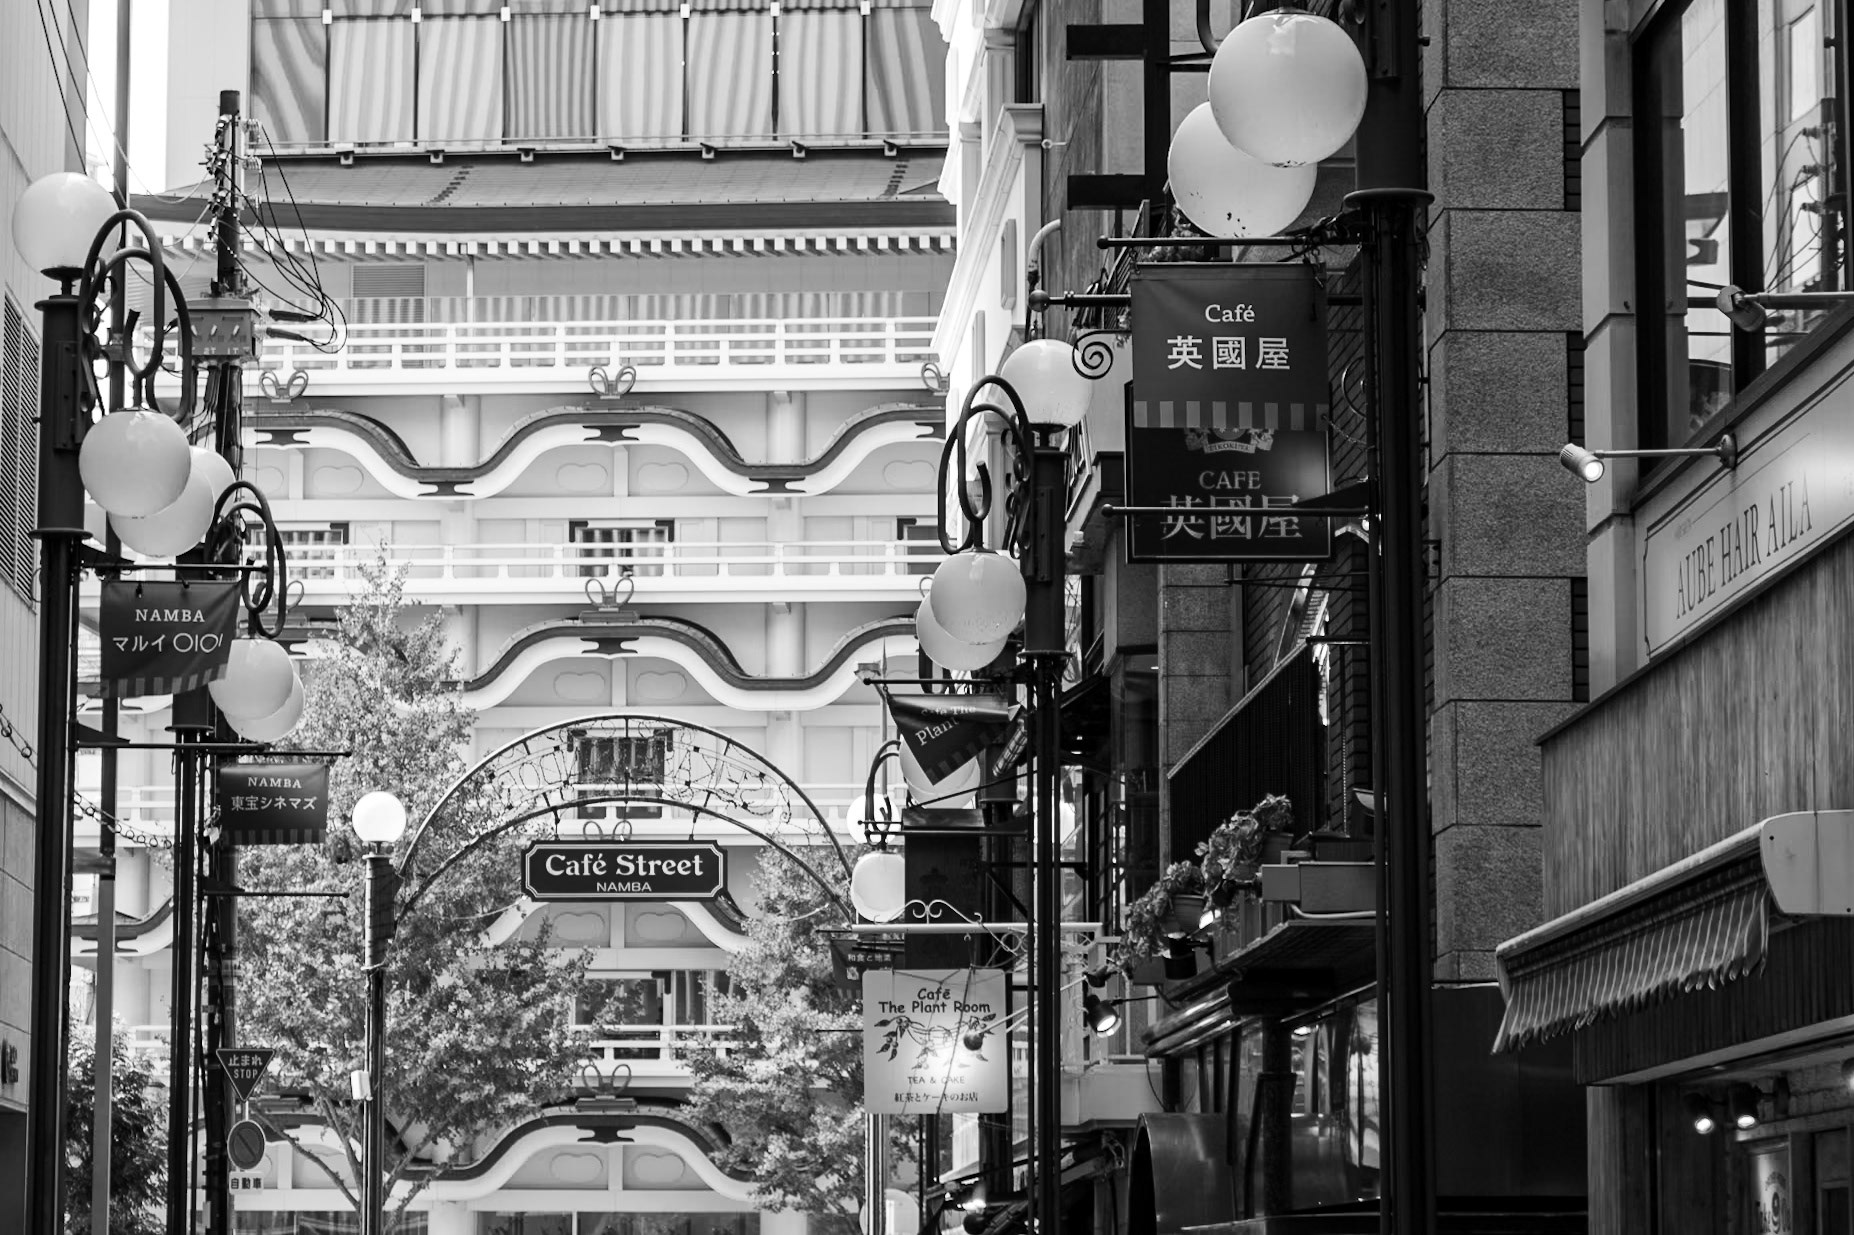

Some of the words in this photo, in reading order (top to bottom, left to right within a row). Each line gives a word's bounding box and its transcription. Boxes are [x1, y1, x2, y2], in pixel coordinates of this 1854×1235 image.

[1204, 304, 1255, 323] Café
[1166, 335, 1291, 370] 英國屋
[1199, 470, 1261, 490] CAFE
[1159, 494, 1303, 541] 英國屋
[1676, 536, 1716, 619] AUBE
[1720, 503, 1762, 587] HAIR
[1766, 471, 1813, 557] AILA
[135, 608, 206, 622] NAMBA
[112, 634, 166, 653] マルイ
[914, 717, 960, 746] Plant
[247, 776, 302, 789] NAMBA
[230, 795, 318, 811] 東宝シネマズ
[545, 852, 607, 877] Café
[616, 854, 704, 876] Street
[596, 881, 652, 893] NAMBA
[878, 1001, 905, 1013] The
[912, 1000, 947, 1013] Plant
[954, 1001, 991, 1013] Room
[228, 1054, 263, 1067] 止まれ
[233, 1069, 258, 1079] STOP
[907, 1076, 925, 1085] TEA
[231, 1177, 262, 1190] 自動車
